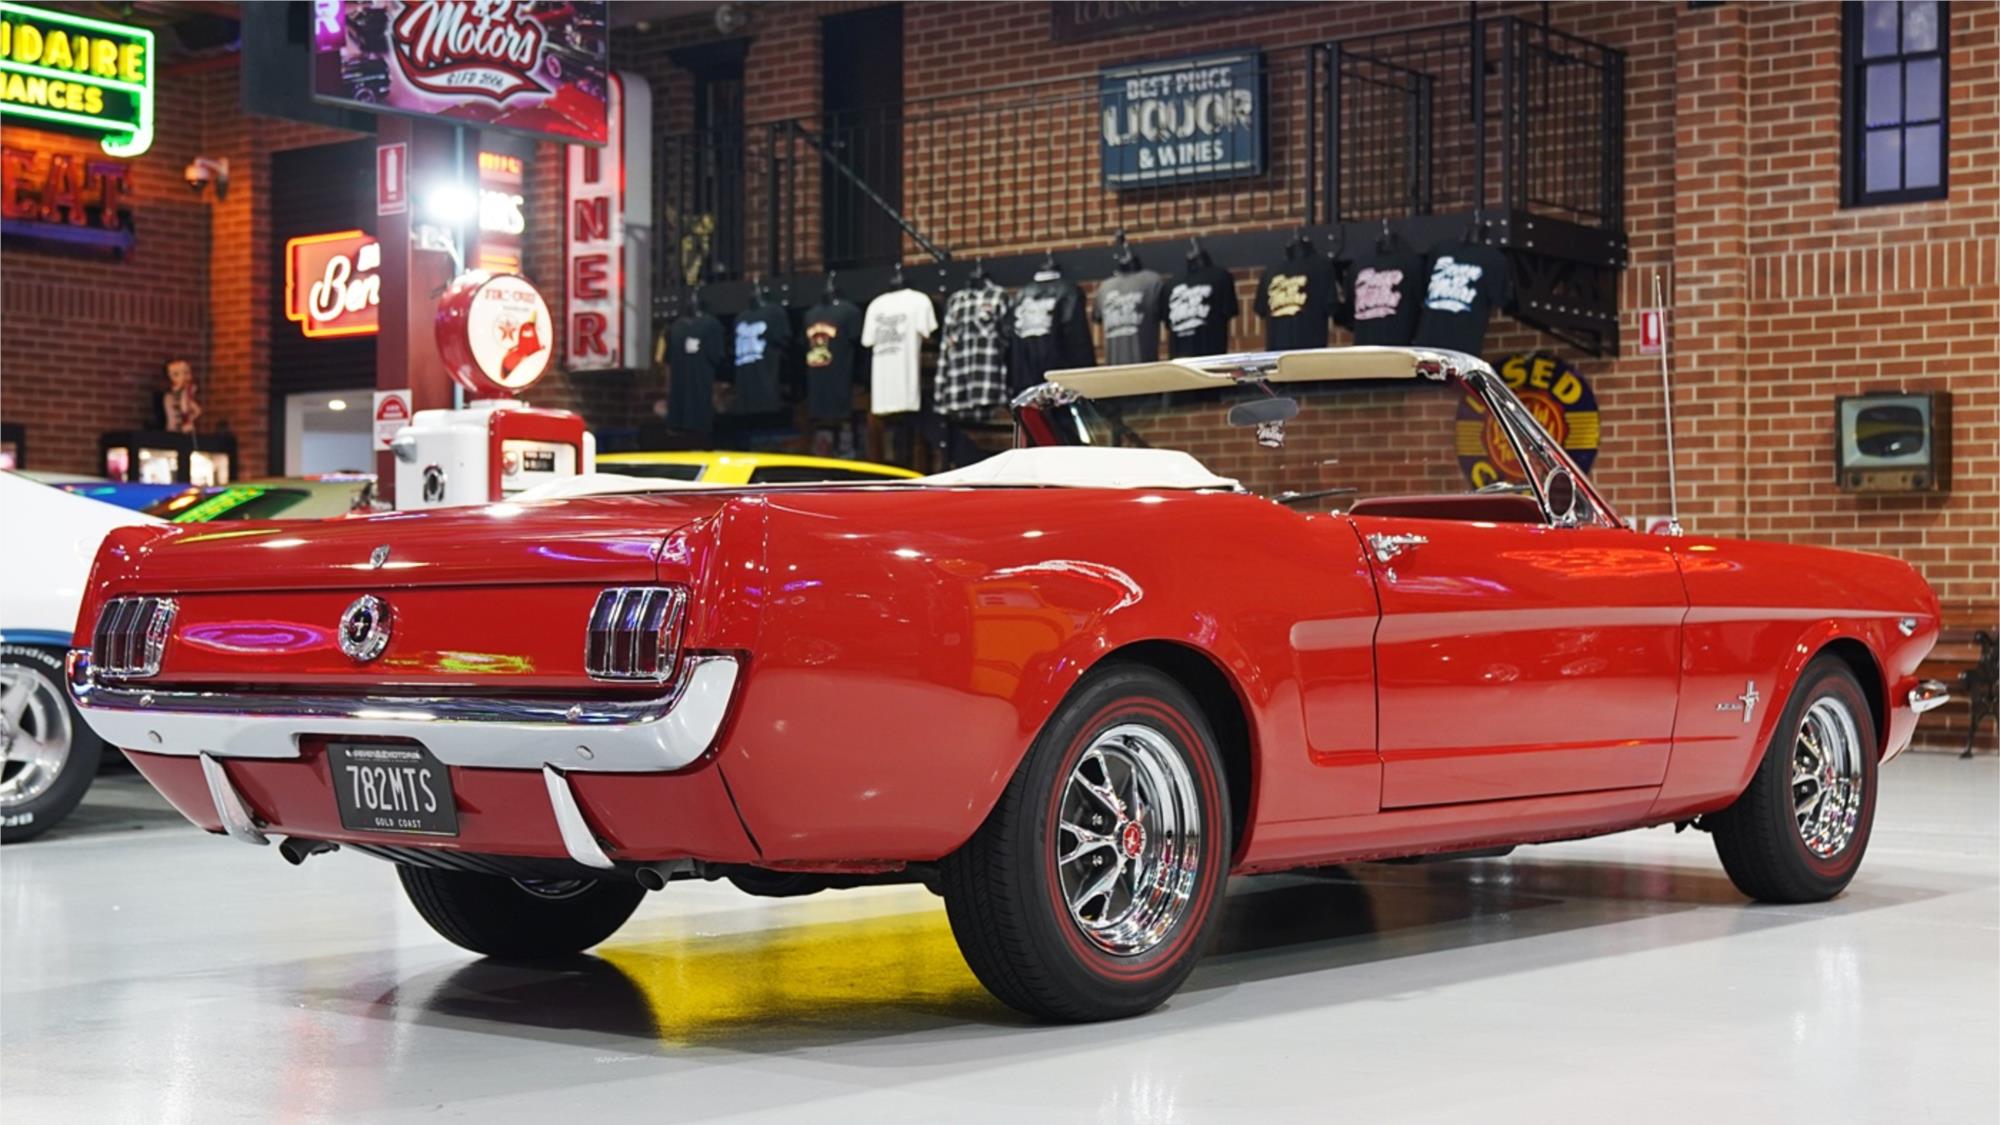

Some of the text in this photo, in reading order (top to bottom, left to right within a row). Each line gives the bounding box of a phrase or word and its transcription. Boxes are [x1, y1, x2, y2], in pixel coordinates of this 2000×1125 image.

[401, 0, 536, 64] Motors
[1126, 67, 1232, 100] BEST PRICE
[1103, 89, 1253, 146] LIQUOR
[1139, 140, 1224, 169] & WINES
[0, 146, 130, 228] EAT
[1466, 355, 1583, 415] SED
[345, 765, 437, 813] 782MTS
[375, 817, 421, 829] GOLD COAST
